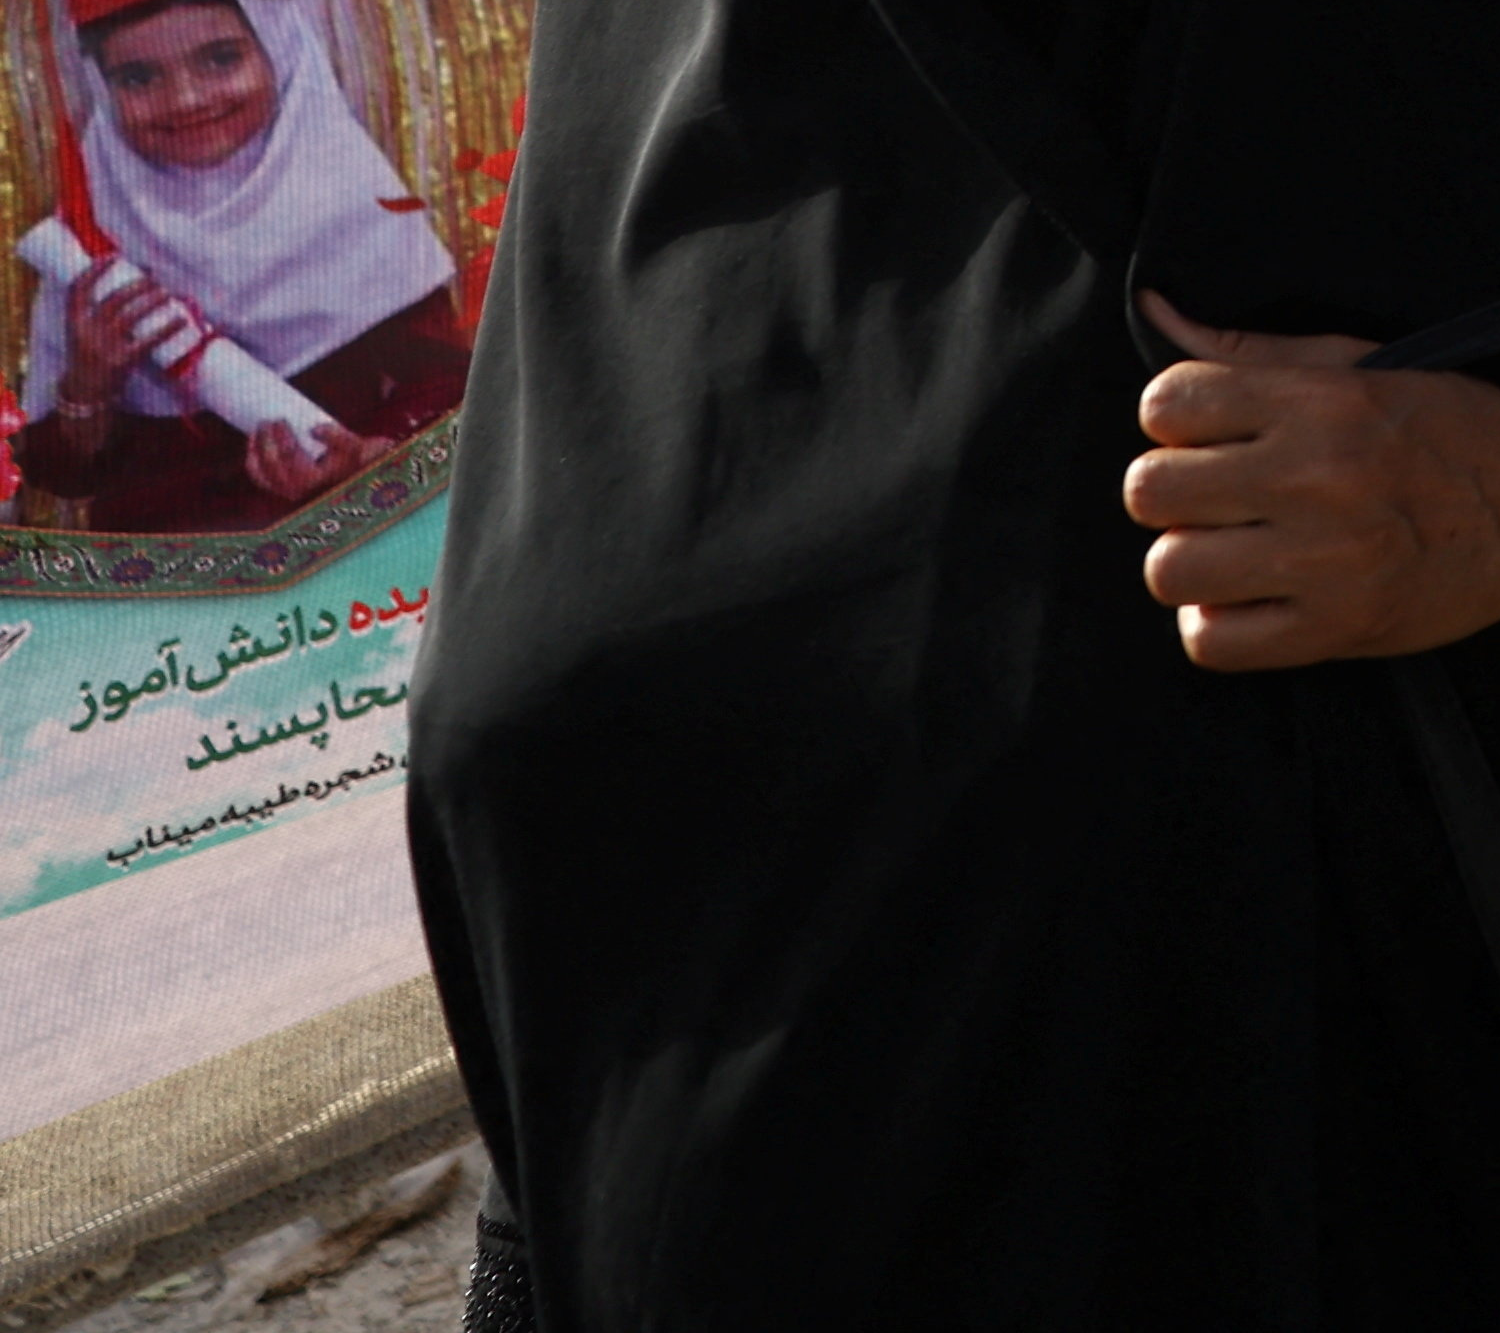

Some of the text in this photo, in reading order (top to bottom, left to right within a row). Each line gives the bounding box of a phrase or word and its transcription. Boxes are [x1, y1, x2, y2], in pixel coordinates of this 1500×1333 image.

[105, 749, 396, 870] شجره طیبه میناب
